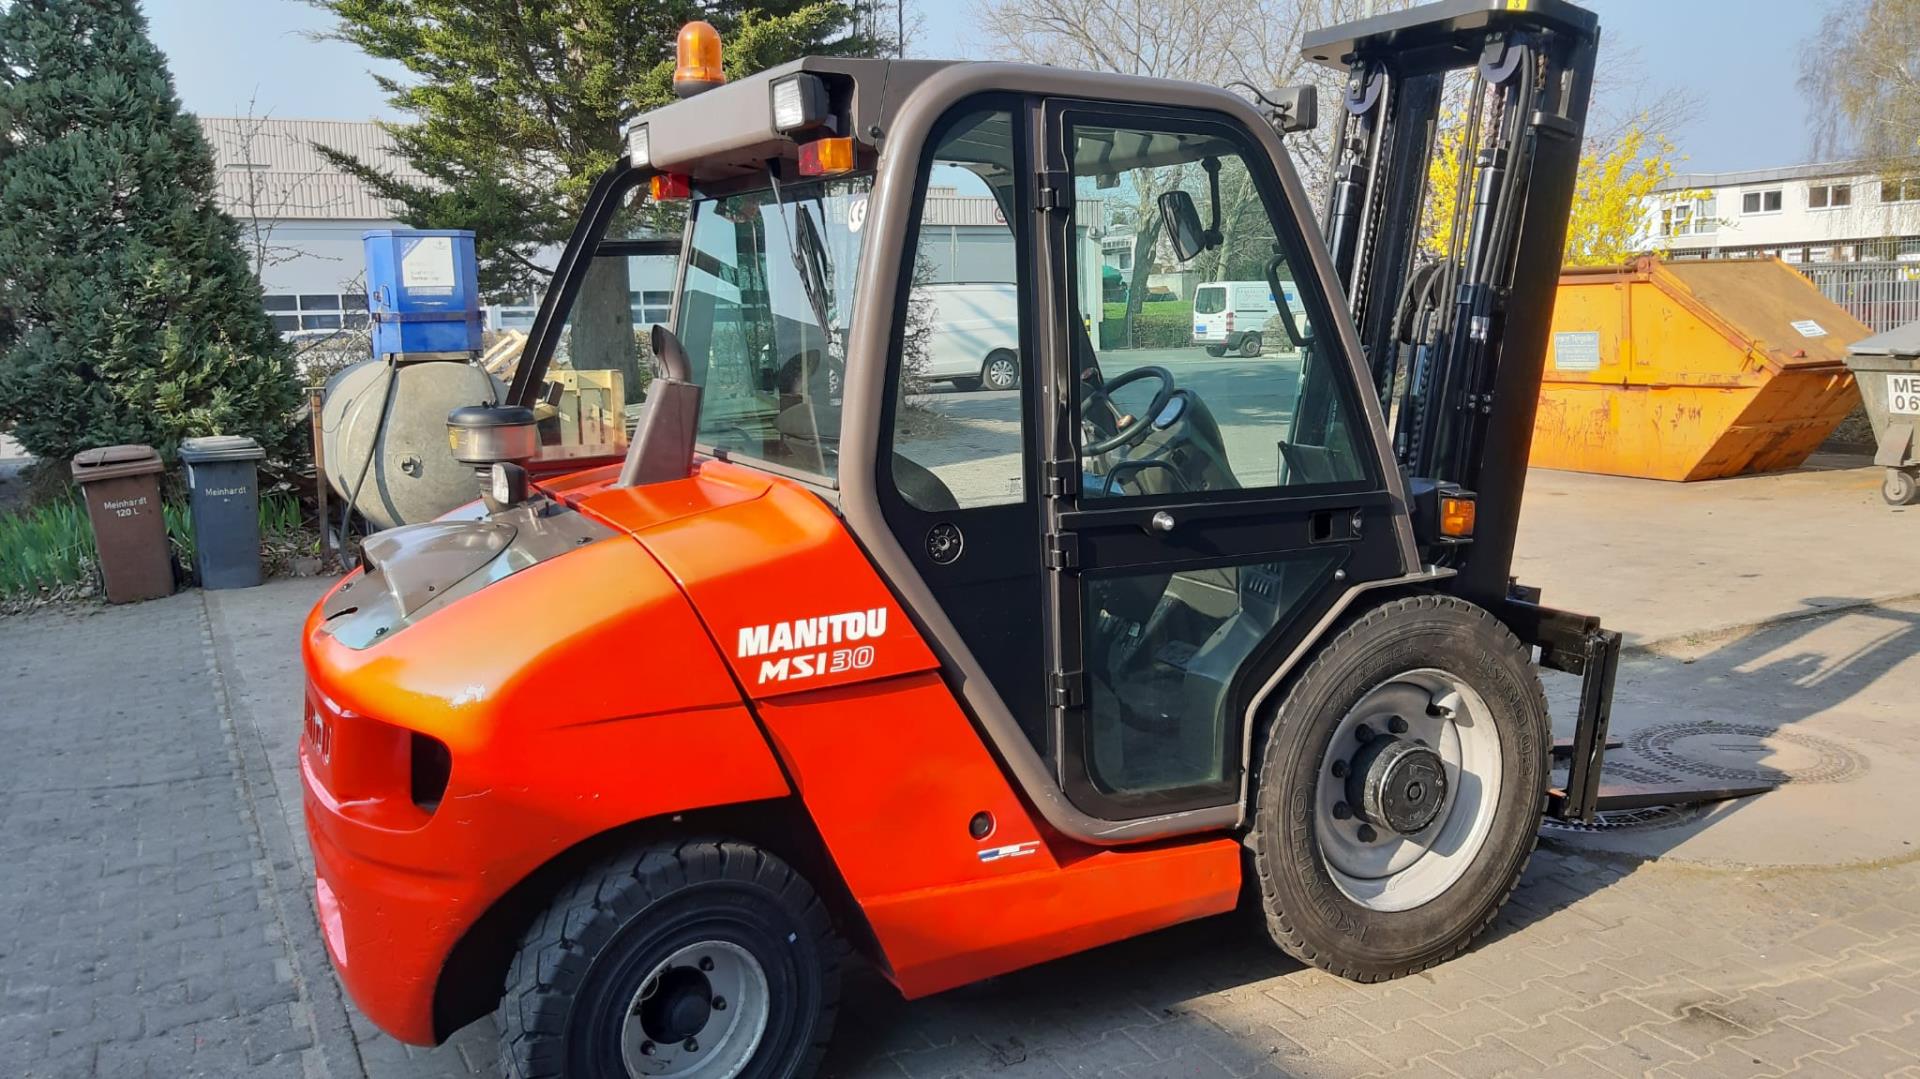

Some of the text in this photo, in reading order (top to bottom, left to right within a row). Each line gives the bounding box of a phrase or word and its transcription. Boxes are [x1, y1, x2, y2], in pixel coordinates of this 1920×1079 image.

[1893, 378, 1920, 394] ME
[205, 486, 247, 497] Meinhardt
[104, 497, 147, 510] Meinhardt
[116, 508, 131, 518] 120
[737, 607, 887, 658] MANITOU
